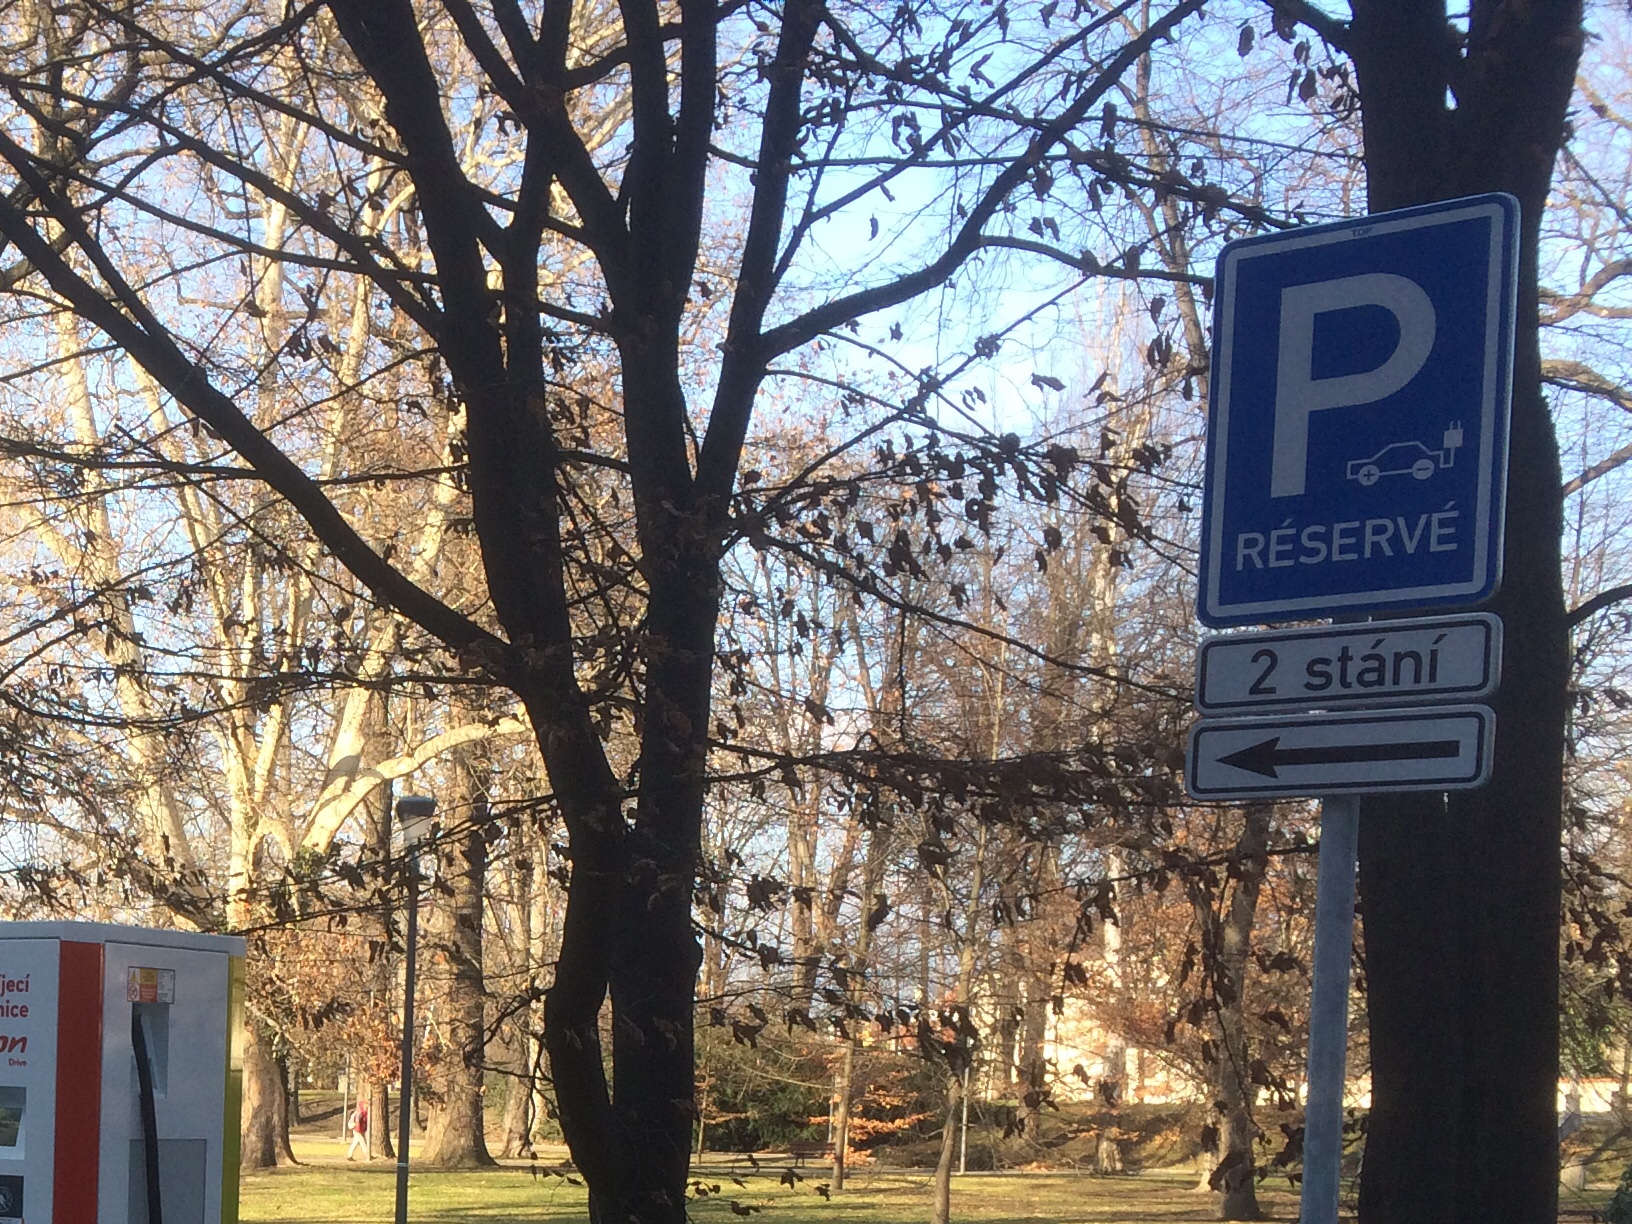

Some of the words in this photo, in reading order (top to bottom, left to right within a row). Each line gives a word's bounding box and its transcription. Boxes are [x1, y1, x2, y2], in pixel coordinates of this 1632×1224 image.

[1270, 272, 1437, 498] P
[1235, 501, 1459, 572] RÉSERVÉ
[1249, 648, 1278, 695] 2
[1304, 634, 1447, 691] stání
[8, 1058, 27, 1067] Drive
